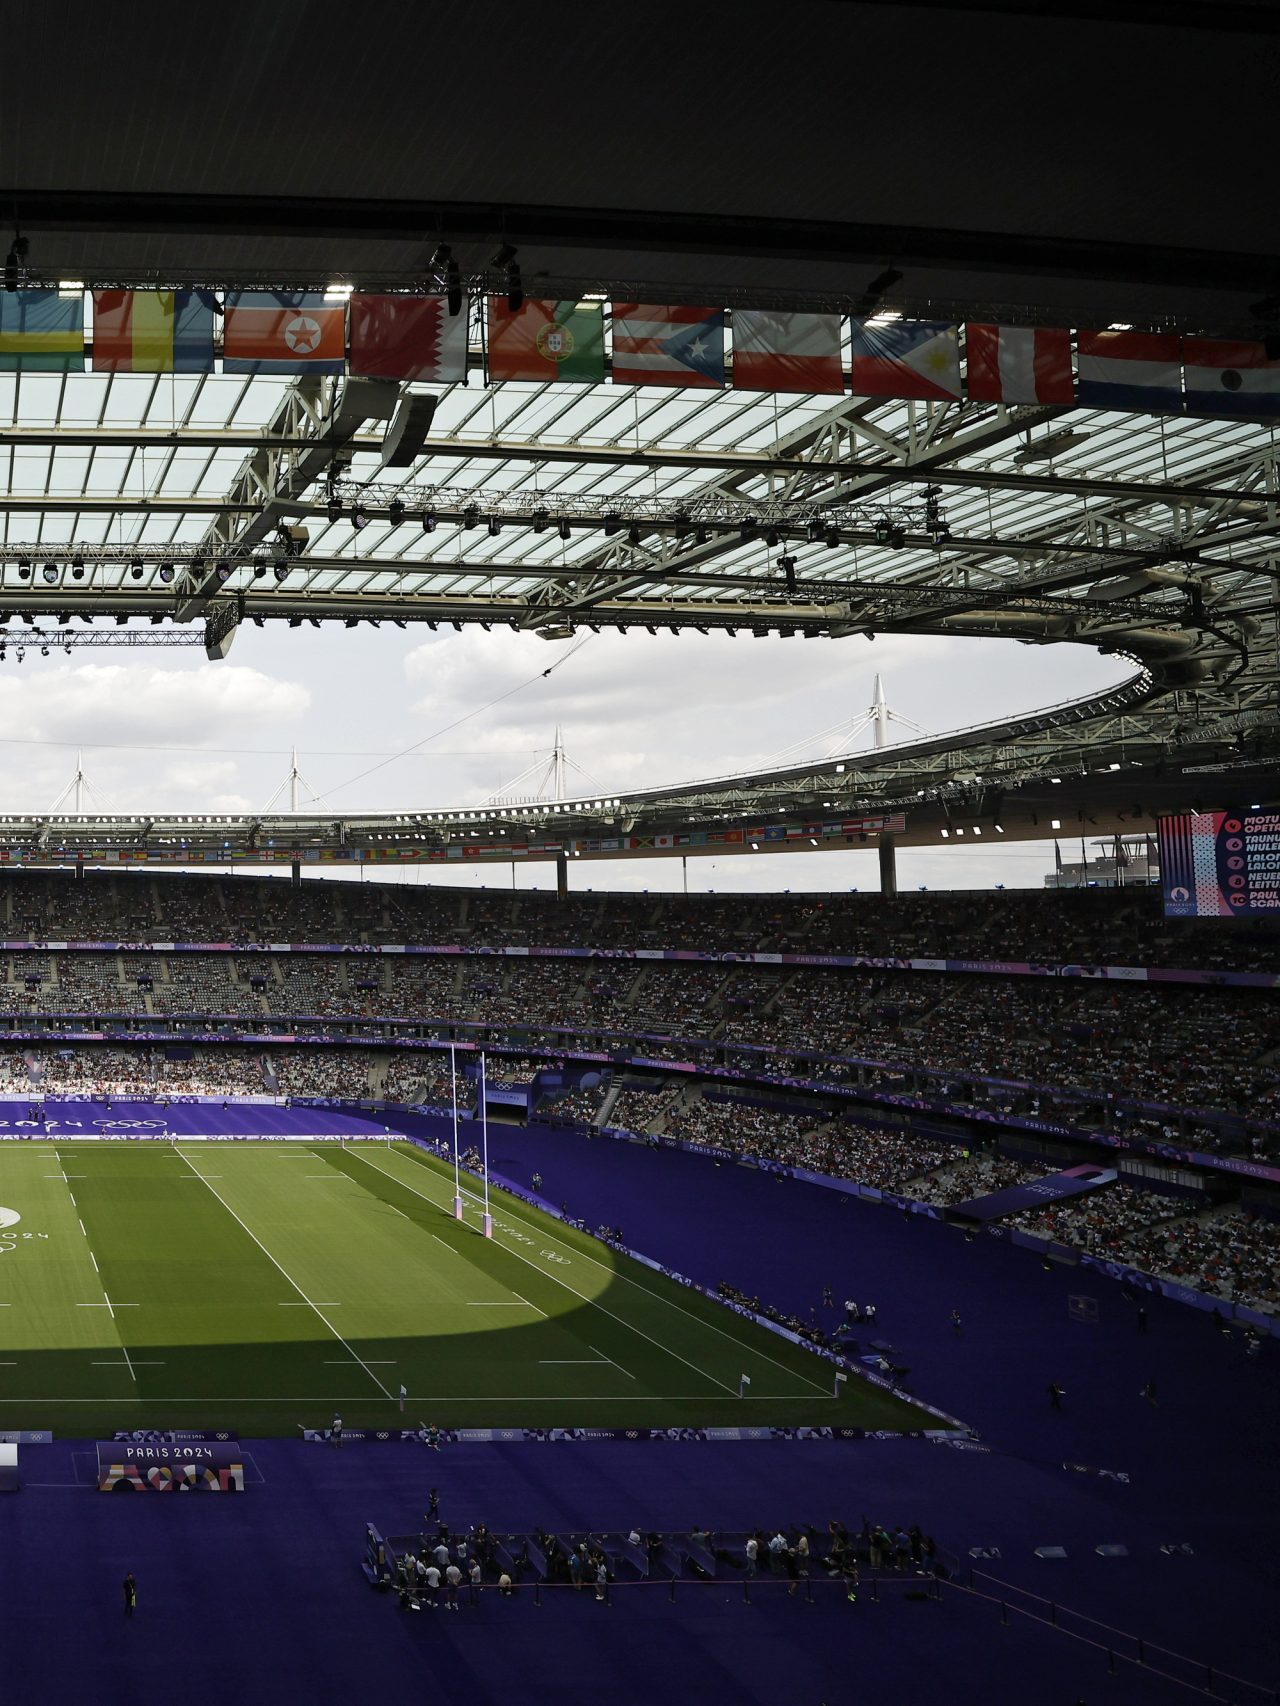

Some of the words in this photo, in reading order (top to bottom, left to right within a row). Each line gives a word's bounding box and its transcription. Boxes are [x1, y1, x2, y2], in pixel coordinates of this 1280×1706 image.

[1244, 815, 1280, 825] MOTU
[1231, 840, 1239, 849] 6
[1233, 858, 1240, 867] 7
[1234, 877, 1242, 886] 8
[1232, 896, 1246, 904] 10
[1249, 891, 1279, 900] PAUL
[823, 1085, 839, 1093] PARIS
[1026, 1121, 1046, 1130] PARIS
[1049, 1126, 1069, 1135] 2024
[689, 1144, 711, 1154] PARIS
[713, 1150, 731, 1158] 2024
[1213, 1159, 1240, 1170] PARIS
[1244, 1165, 1269, 1177] 2024
[126, 1447, 169, 1458] PARIS
[174, 1447, 212, 1458] 2024
